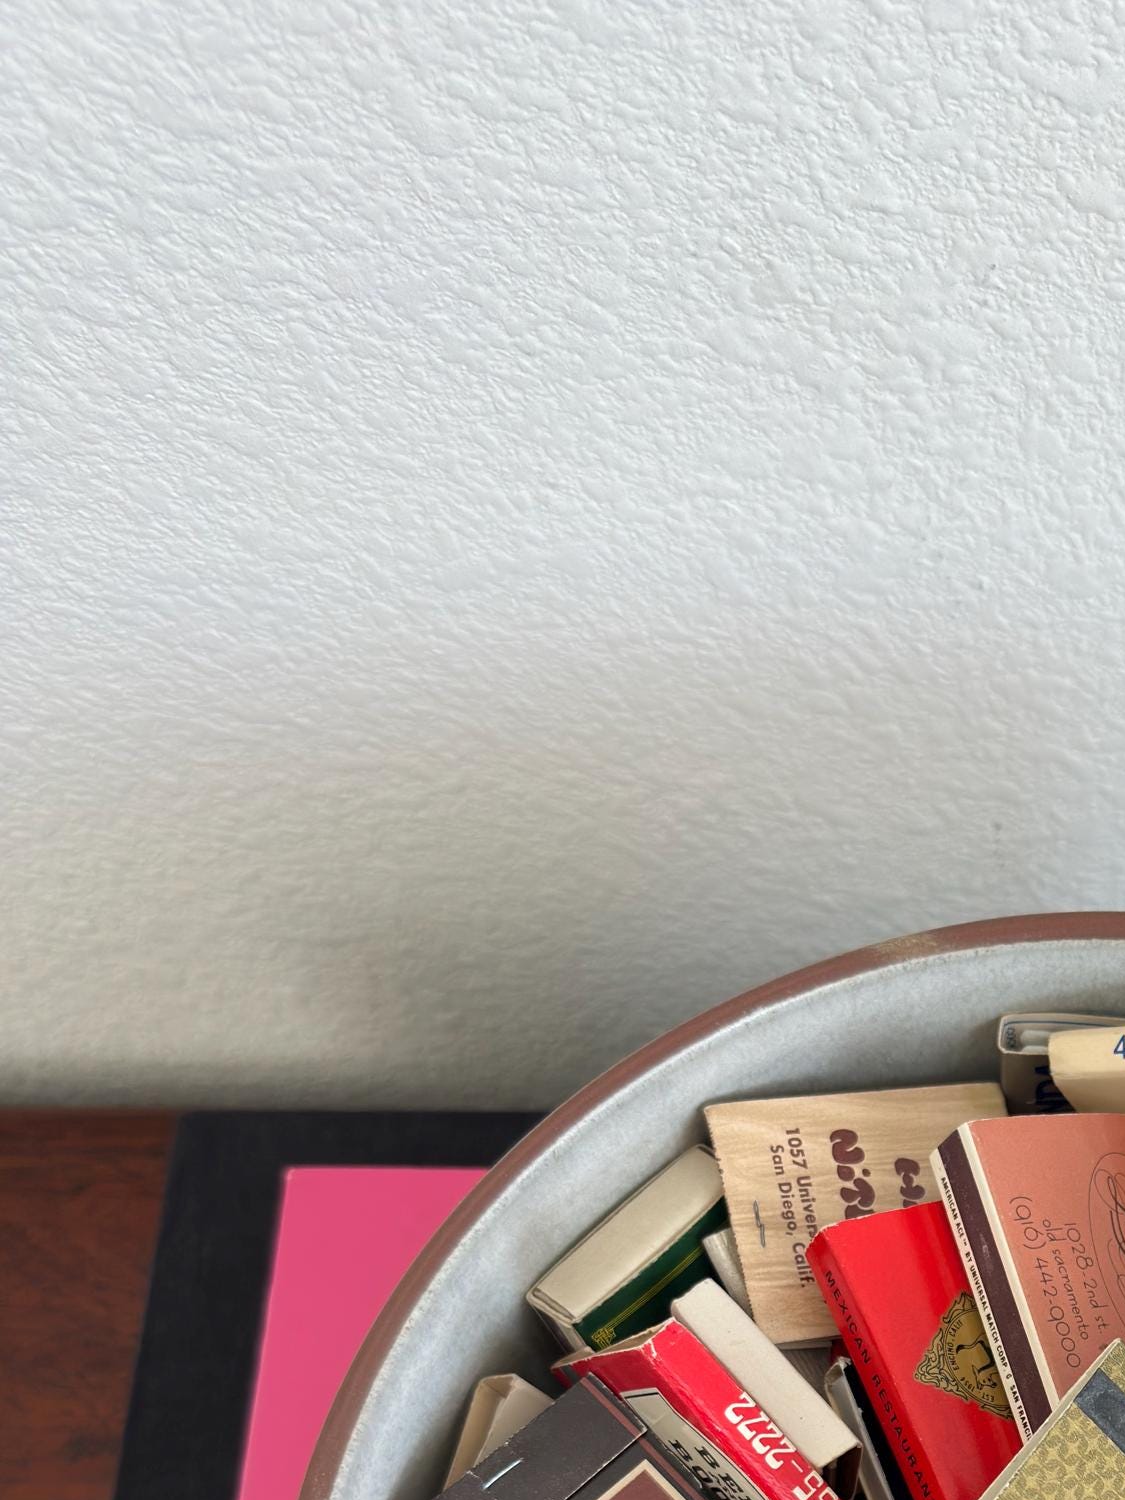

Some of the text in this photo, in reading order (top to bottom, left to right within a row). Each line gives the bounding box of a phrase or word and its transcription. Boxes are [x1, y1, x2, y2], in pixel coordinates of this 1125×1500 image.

[785, 1127, 808, 1171] 1057
[770, 1144, 816, 1288] San Diego, Calif.
[1009, 1196, 1082, 1368] (916) 442-9000
[1042, 1218, 1090, 1341] old sacramento
[825, 1271, 870, 1364] MEXICAN
[941, 1177, 960, 1221] AMERICAN
[969, 1264, 989, 1311] UNIVERSAL
[986, 1312, 1001, 1346] MATCH
[1008, 1384, 1020, 1406] SAN
